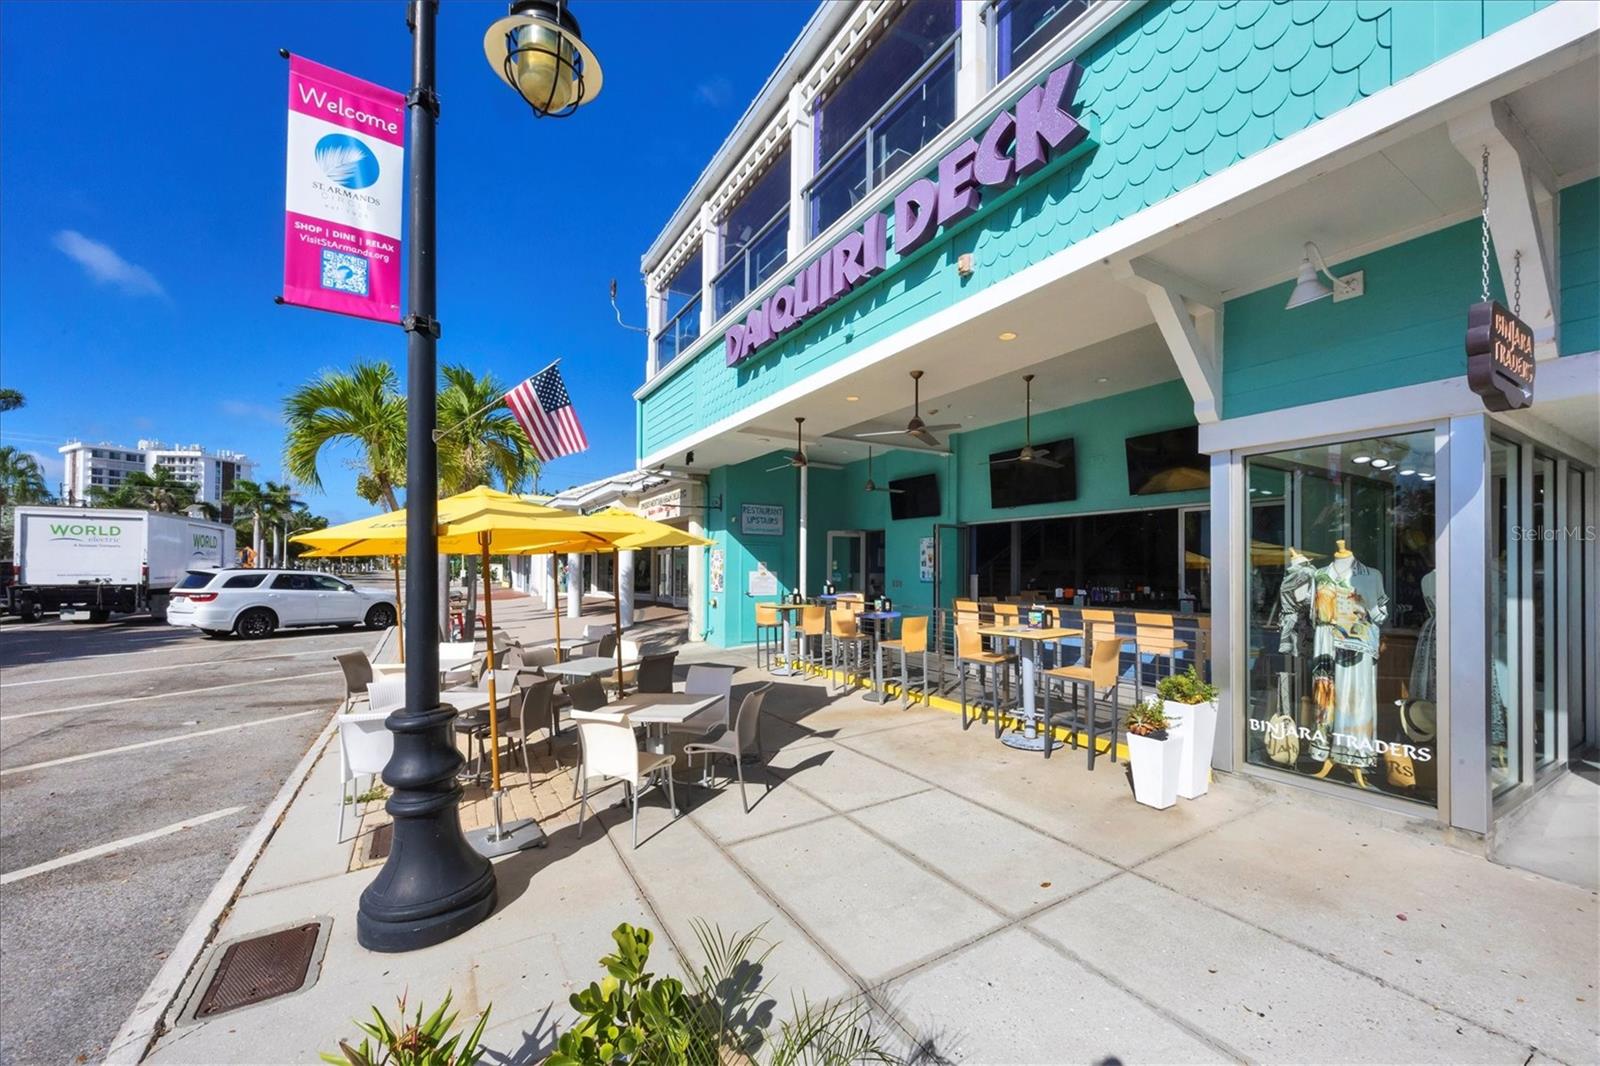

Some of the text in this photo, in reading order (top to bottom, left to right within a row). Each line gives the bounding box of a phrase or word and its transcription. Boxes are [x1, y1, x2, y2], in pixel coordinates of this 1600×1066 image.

[298, 82, 398, 134] Welcome
[327, 185, 381, 206] ARMANDS
[725, 58, 1090, 368] DAIQUIRI DECK
[294, 220, 395, 253] SHOP DINE RELAX
[299, 232, 390, 264] VisitStArmands.org
[742, 506, 784, 517] RESTAURANT
[746, 516, 778, 525] UPSTAIRS
[50, 524, 121, 536] WORLD
[193, 534, 218, 550] WORLD
[1249, 718, 1329, 744] BINJARA
[1332, 732, 1432, 762] TRADERS
